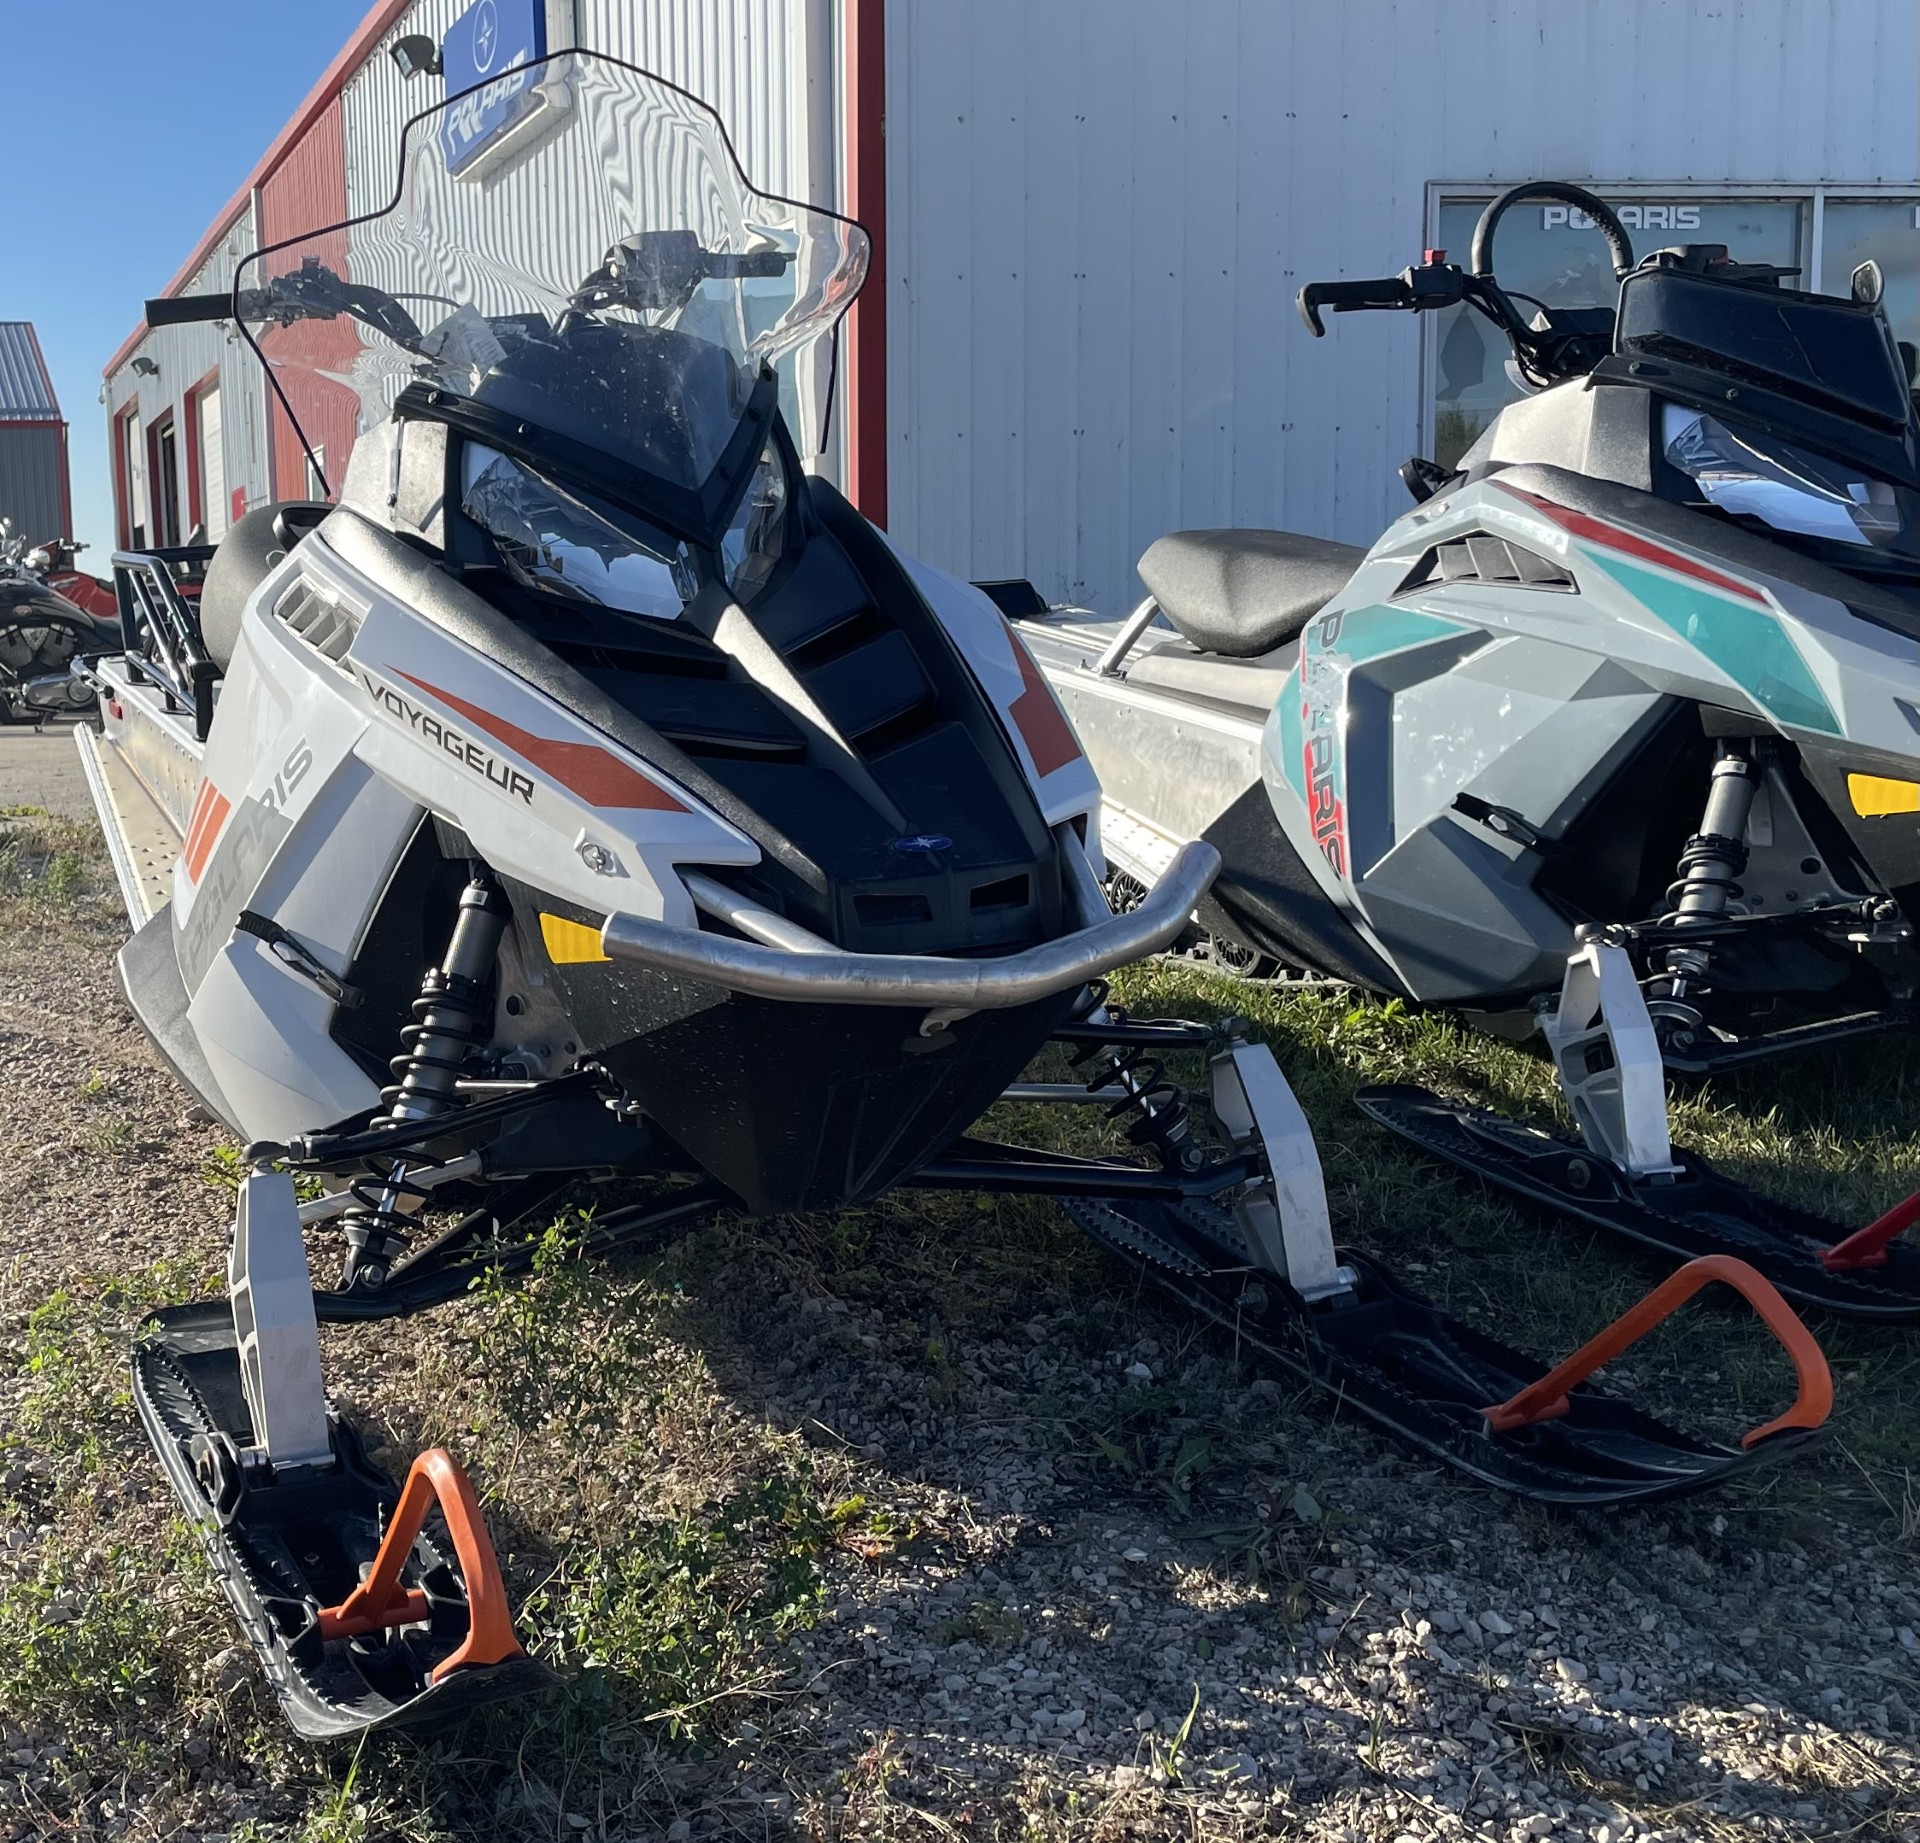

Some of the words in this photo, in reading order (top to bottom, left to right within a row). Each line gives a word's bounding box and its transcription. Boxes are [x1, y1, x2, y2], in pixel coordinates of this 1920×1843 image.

[1543, 206, 1700, 230] POARIS
[363, 673, 535, 806] VOYAGEUR
[188, 735, 313, 975] POLARIS
